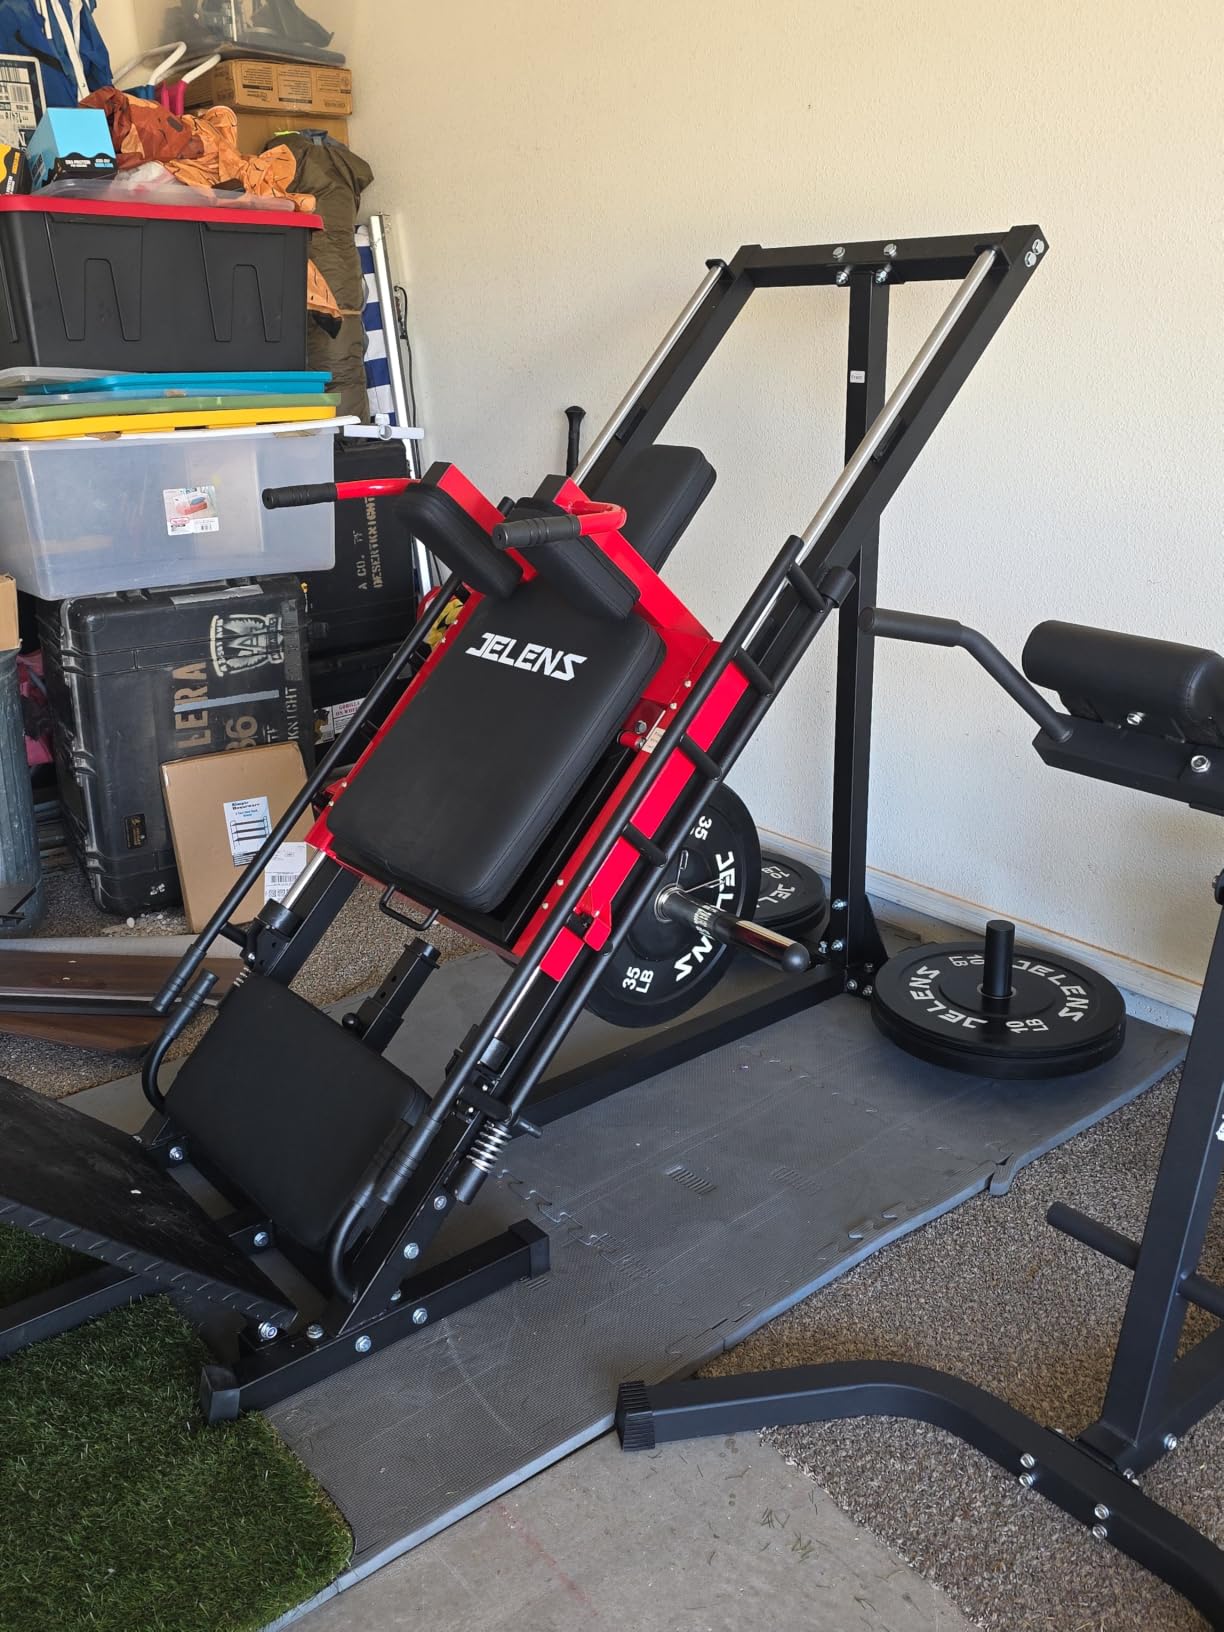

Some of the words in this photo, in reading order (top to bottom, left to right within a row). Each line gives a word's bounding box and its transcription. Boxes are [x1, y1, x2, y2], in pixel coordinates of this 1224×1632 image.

[465, 632, 588, 681] JELENS
[284, 686, 300, 741] KNIGHT
[694, 815, 713, 841] 35
[761, 865, 782, 874] LB
[769, 871, 791, 879] 10
[756, 883, 796, 908] JEL
[673, 851, 735, 982] JELNS
[948, 955, 969, 967] LB
[622, 966, 641, 990] 35
[635, 969, 655, 994] LB
[1012, 959, 1089, 1022] JELENS
[908, 965, 989, 1029] JELENS
[1005, 1020, 1029, 1034] 10
[1025, 1018, 1049, 1033] LB
